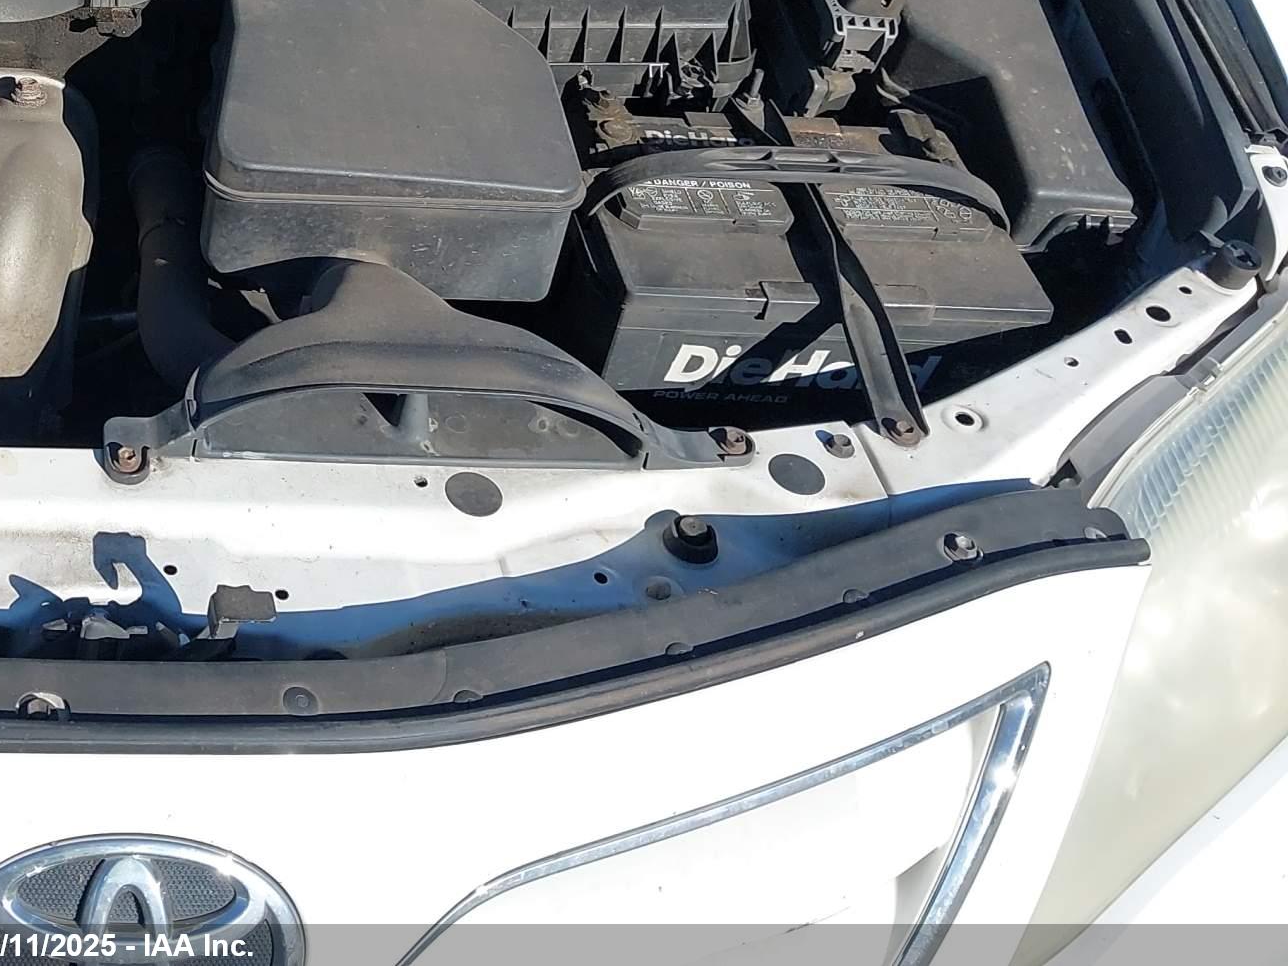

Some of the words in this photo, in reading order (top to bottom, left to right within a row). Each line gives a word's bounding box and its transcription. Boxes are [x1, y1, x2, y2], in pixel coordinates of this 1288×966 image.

[663, 343, 942, 393] DieHad
[653, 390, 718, 400] POWER
[723, 393, 788, 403] AHEAD
